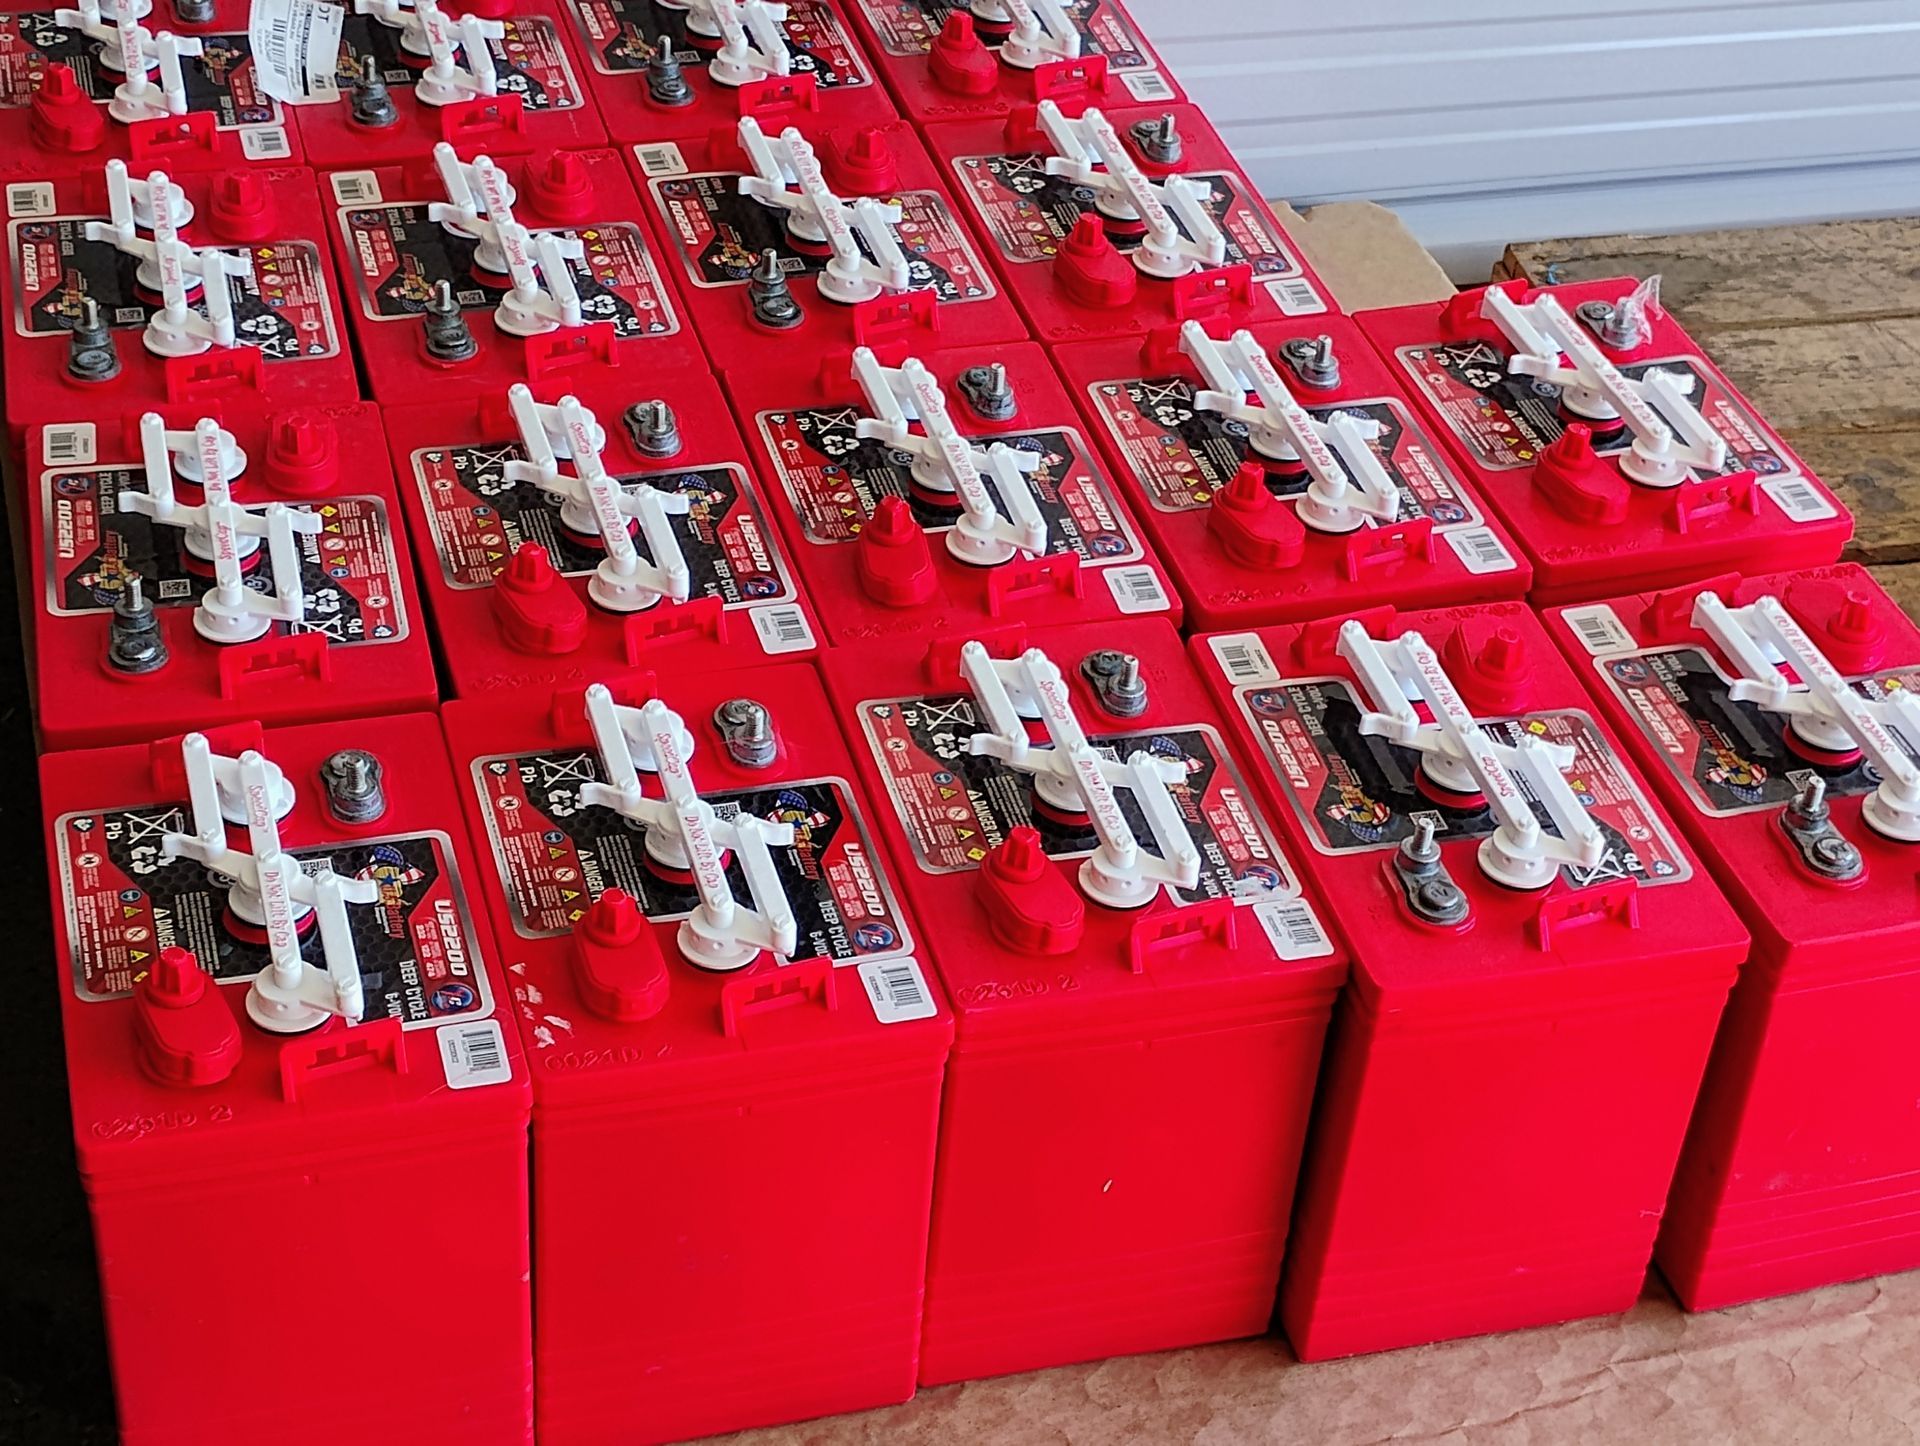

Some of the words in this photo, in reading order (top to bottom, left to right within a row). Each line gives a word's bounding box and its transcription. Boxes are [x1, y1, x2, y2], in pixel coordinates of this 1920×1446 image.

[669, 200, 699, 245] US2200
[1238, 210, 1277, 254] US2200
[355, 230, 380, 277] US2200
[23, 244, 40, 291] US2200
[944, 280, 960, 295] Pb
[626, 316, 641, 331] Pb
[285, 338, 299, 352] Pb
[1434, 353, 1451, 366] Pb
[1127, 389, 1143, 402] Pb
[797, 417, 812, 430] Pb
[1714, 400, 1769, 451] US2200
[452, 456, 469, 470] Pb
[1407, 446, 1454, 499] US2200
[99, 472, 114, 495] CYCLE
[100, 496, 115, 516] DEEP
[1077, 477, 1117, 531] US2200
[58, 500, 75, 559] US2200
[1059, 518, 1078, 537] DEEP
[737, 514, 772, 572] US2200
[713, 559, 731, 578] DEEP
[721, 579, 742, 602] CYCLE
[347, 618, 364, 634] Pb
[1646, 656, 1671, 681] CYCLE
[1288, 687, 1312, 713] CYCLE
[1666, 681, 1690, 704] DEEP
[902, 710, 919, 727] Pb
[1305, 716, 1325, 737] DEEP
[1627, 689, 1685, 754] US2200
[1263, 721, 1310, 789] US2200
[520, 766, 538, 783] Pb
[105, 822, 123, 839] Pb
[1220, 788, 1269, 859] US2200
[692, 842, 708, 859] Lift
[1204, 842, 1225, 866] DEEP
[1623, 853, 1645, 871] Pb
[265, 871, 280, 882] Do
[581, 860, 604, 891] DANGER
[699, 862, 714, 873] By
[704, 873, 719, 889] Cap
[843, 843, 885, 916] US2200
[1200, 872, 1223, 899] 6-VOLT
[271, 901, 287, 917] Lift
[818, 900, 842, 925] DEEP
[271, 920, 288, 929] By
[274, 931, 290, 948] Cap
[434, 900, 468, 976] US2200
[809, 930, 829, 957] 6-VOL
[828, 926, 853, 958] CYCLE
[399, 960, 419, 986] DEEP
[385, 992, 404, 1019] 6-VOL
[405, 987, 428, 1020] CYCLE
